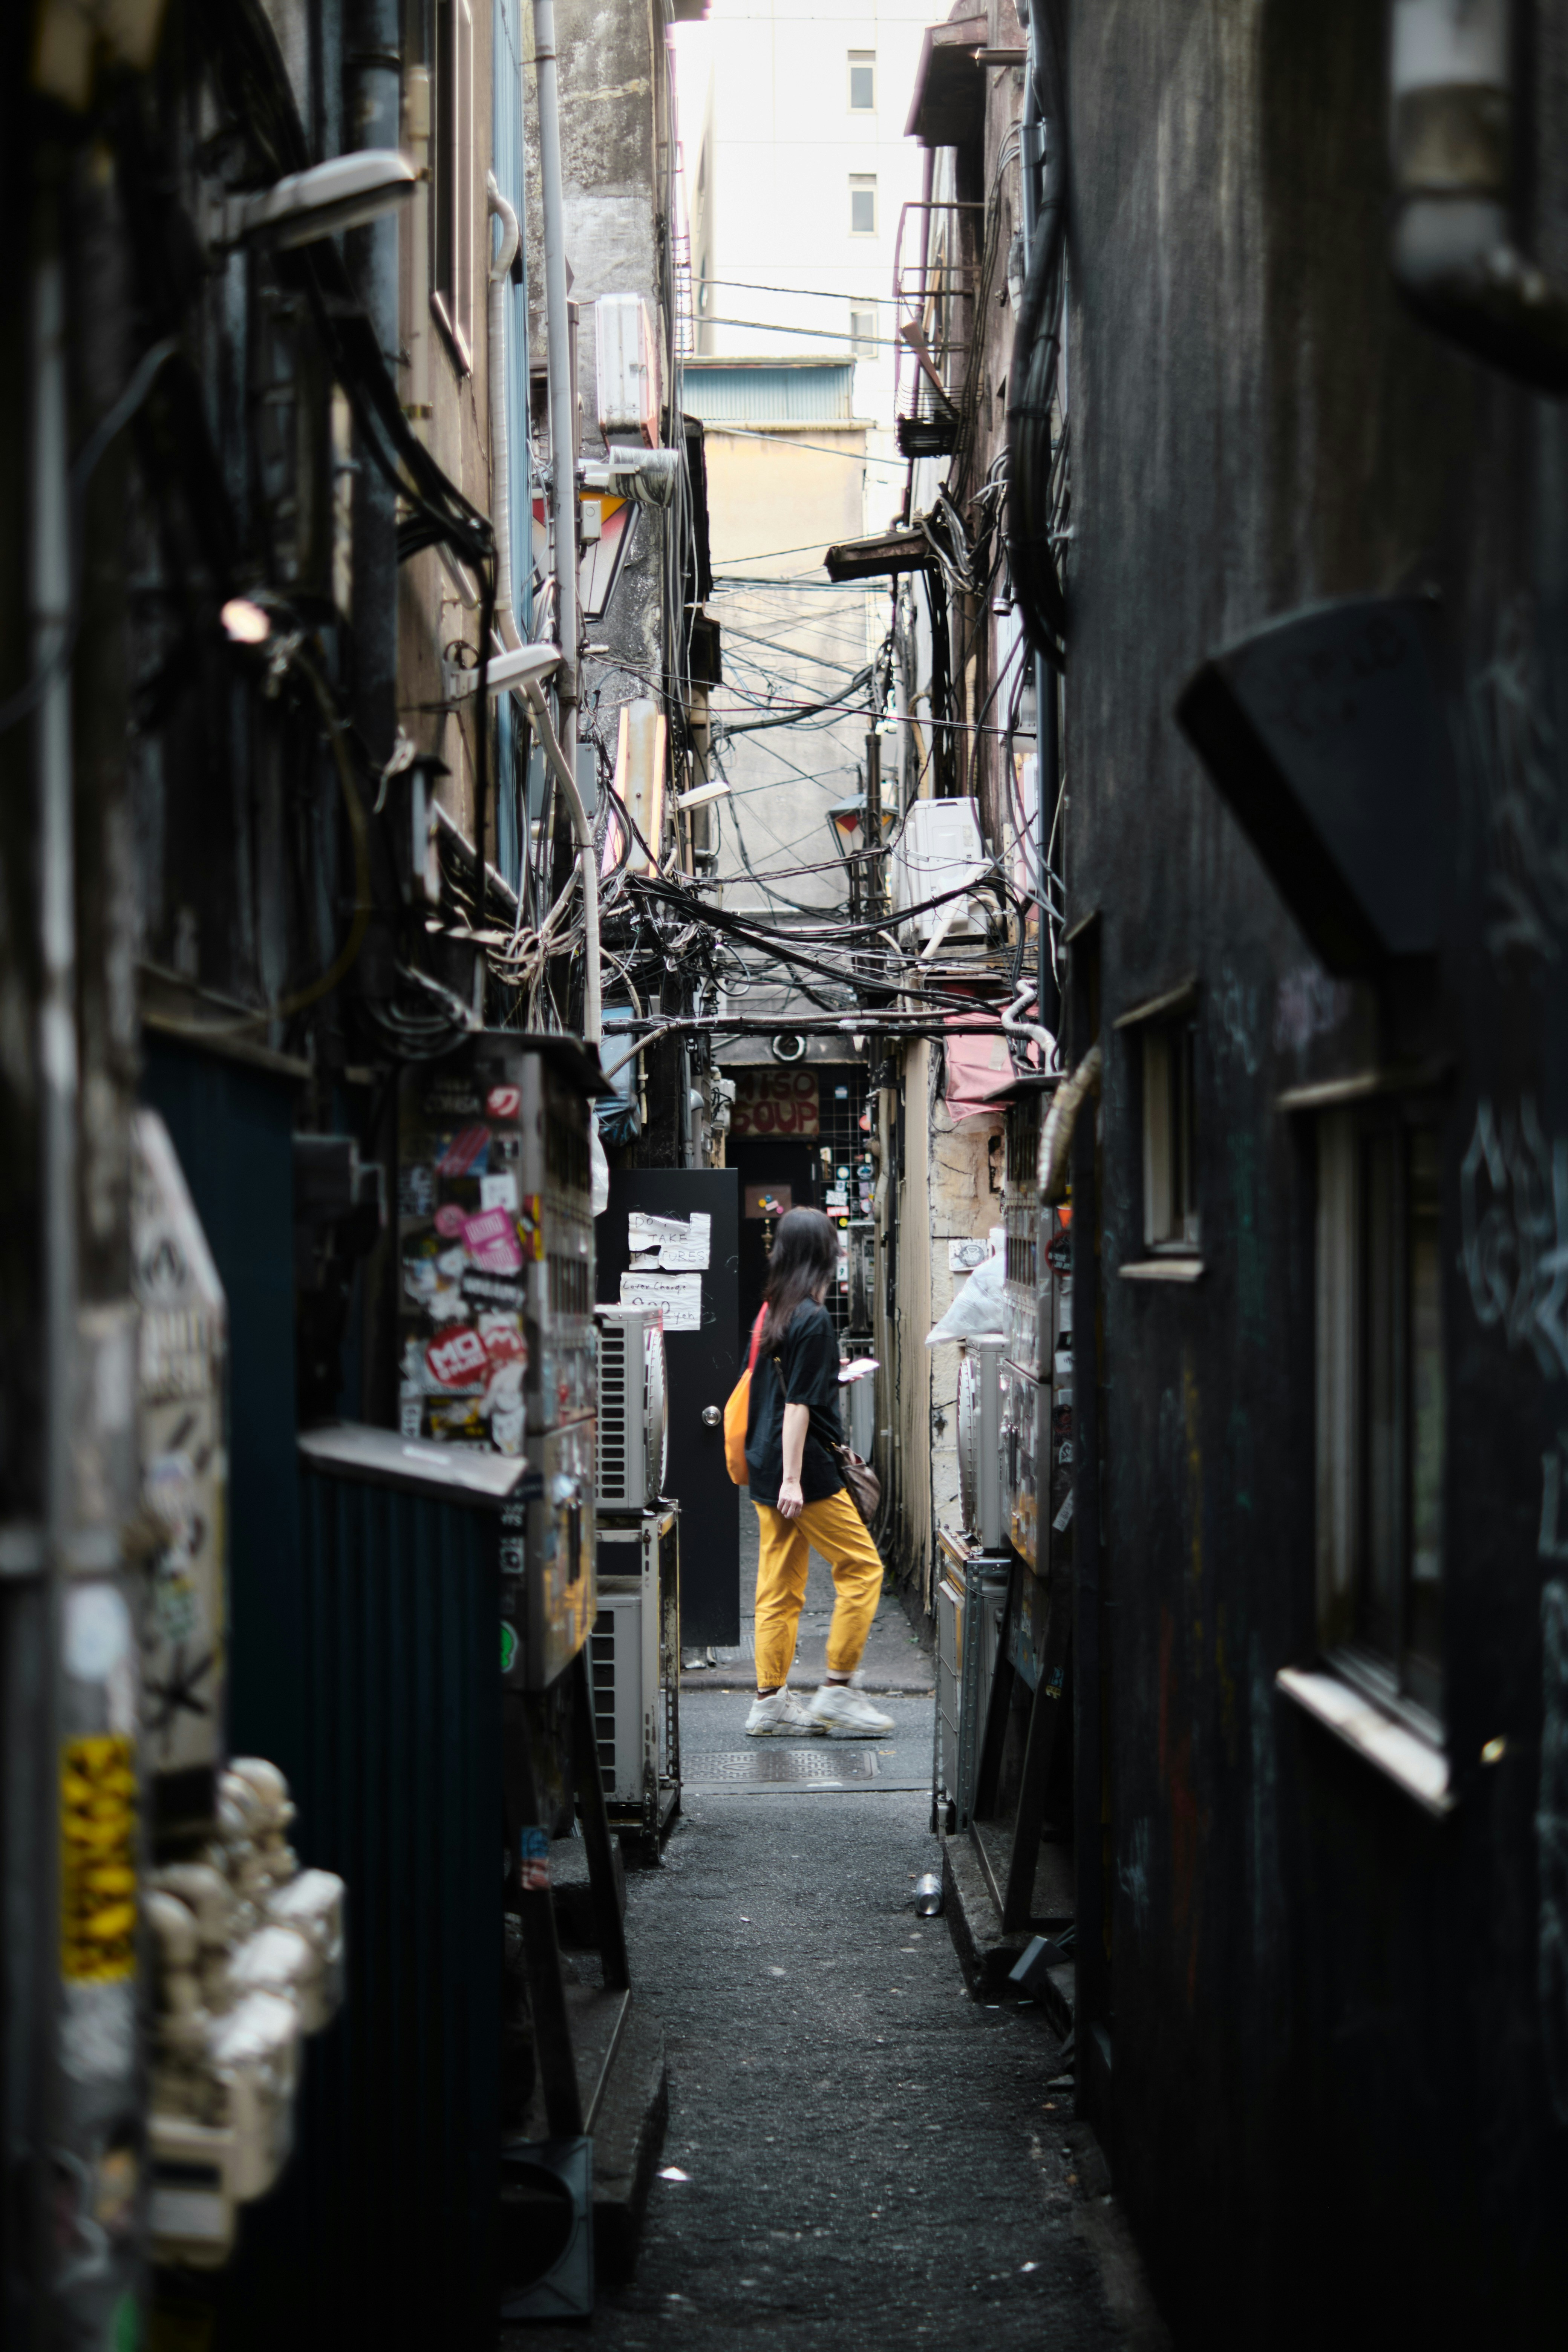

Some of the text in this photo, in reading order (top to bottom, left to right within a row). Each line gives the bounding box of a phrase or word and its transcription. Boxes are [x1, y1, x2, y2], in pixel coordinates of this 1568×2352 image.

[730, 1100, 817, 1133] SOUP
[648, 1234, 688, 1244] TAKE
[623, 1281, 686, 1295] Cover Charge
[674, 1312, 694, 1325] yen
